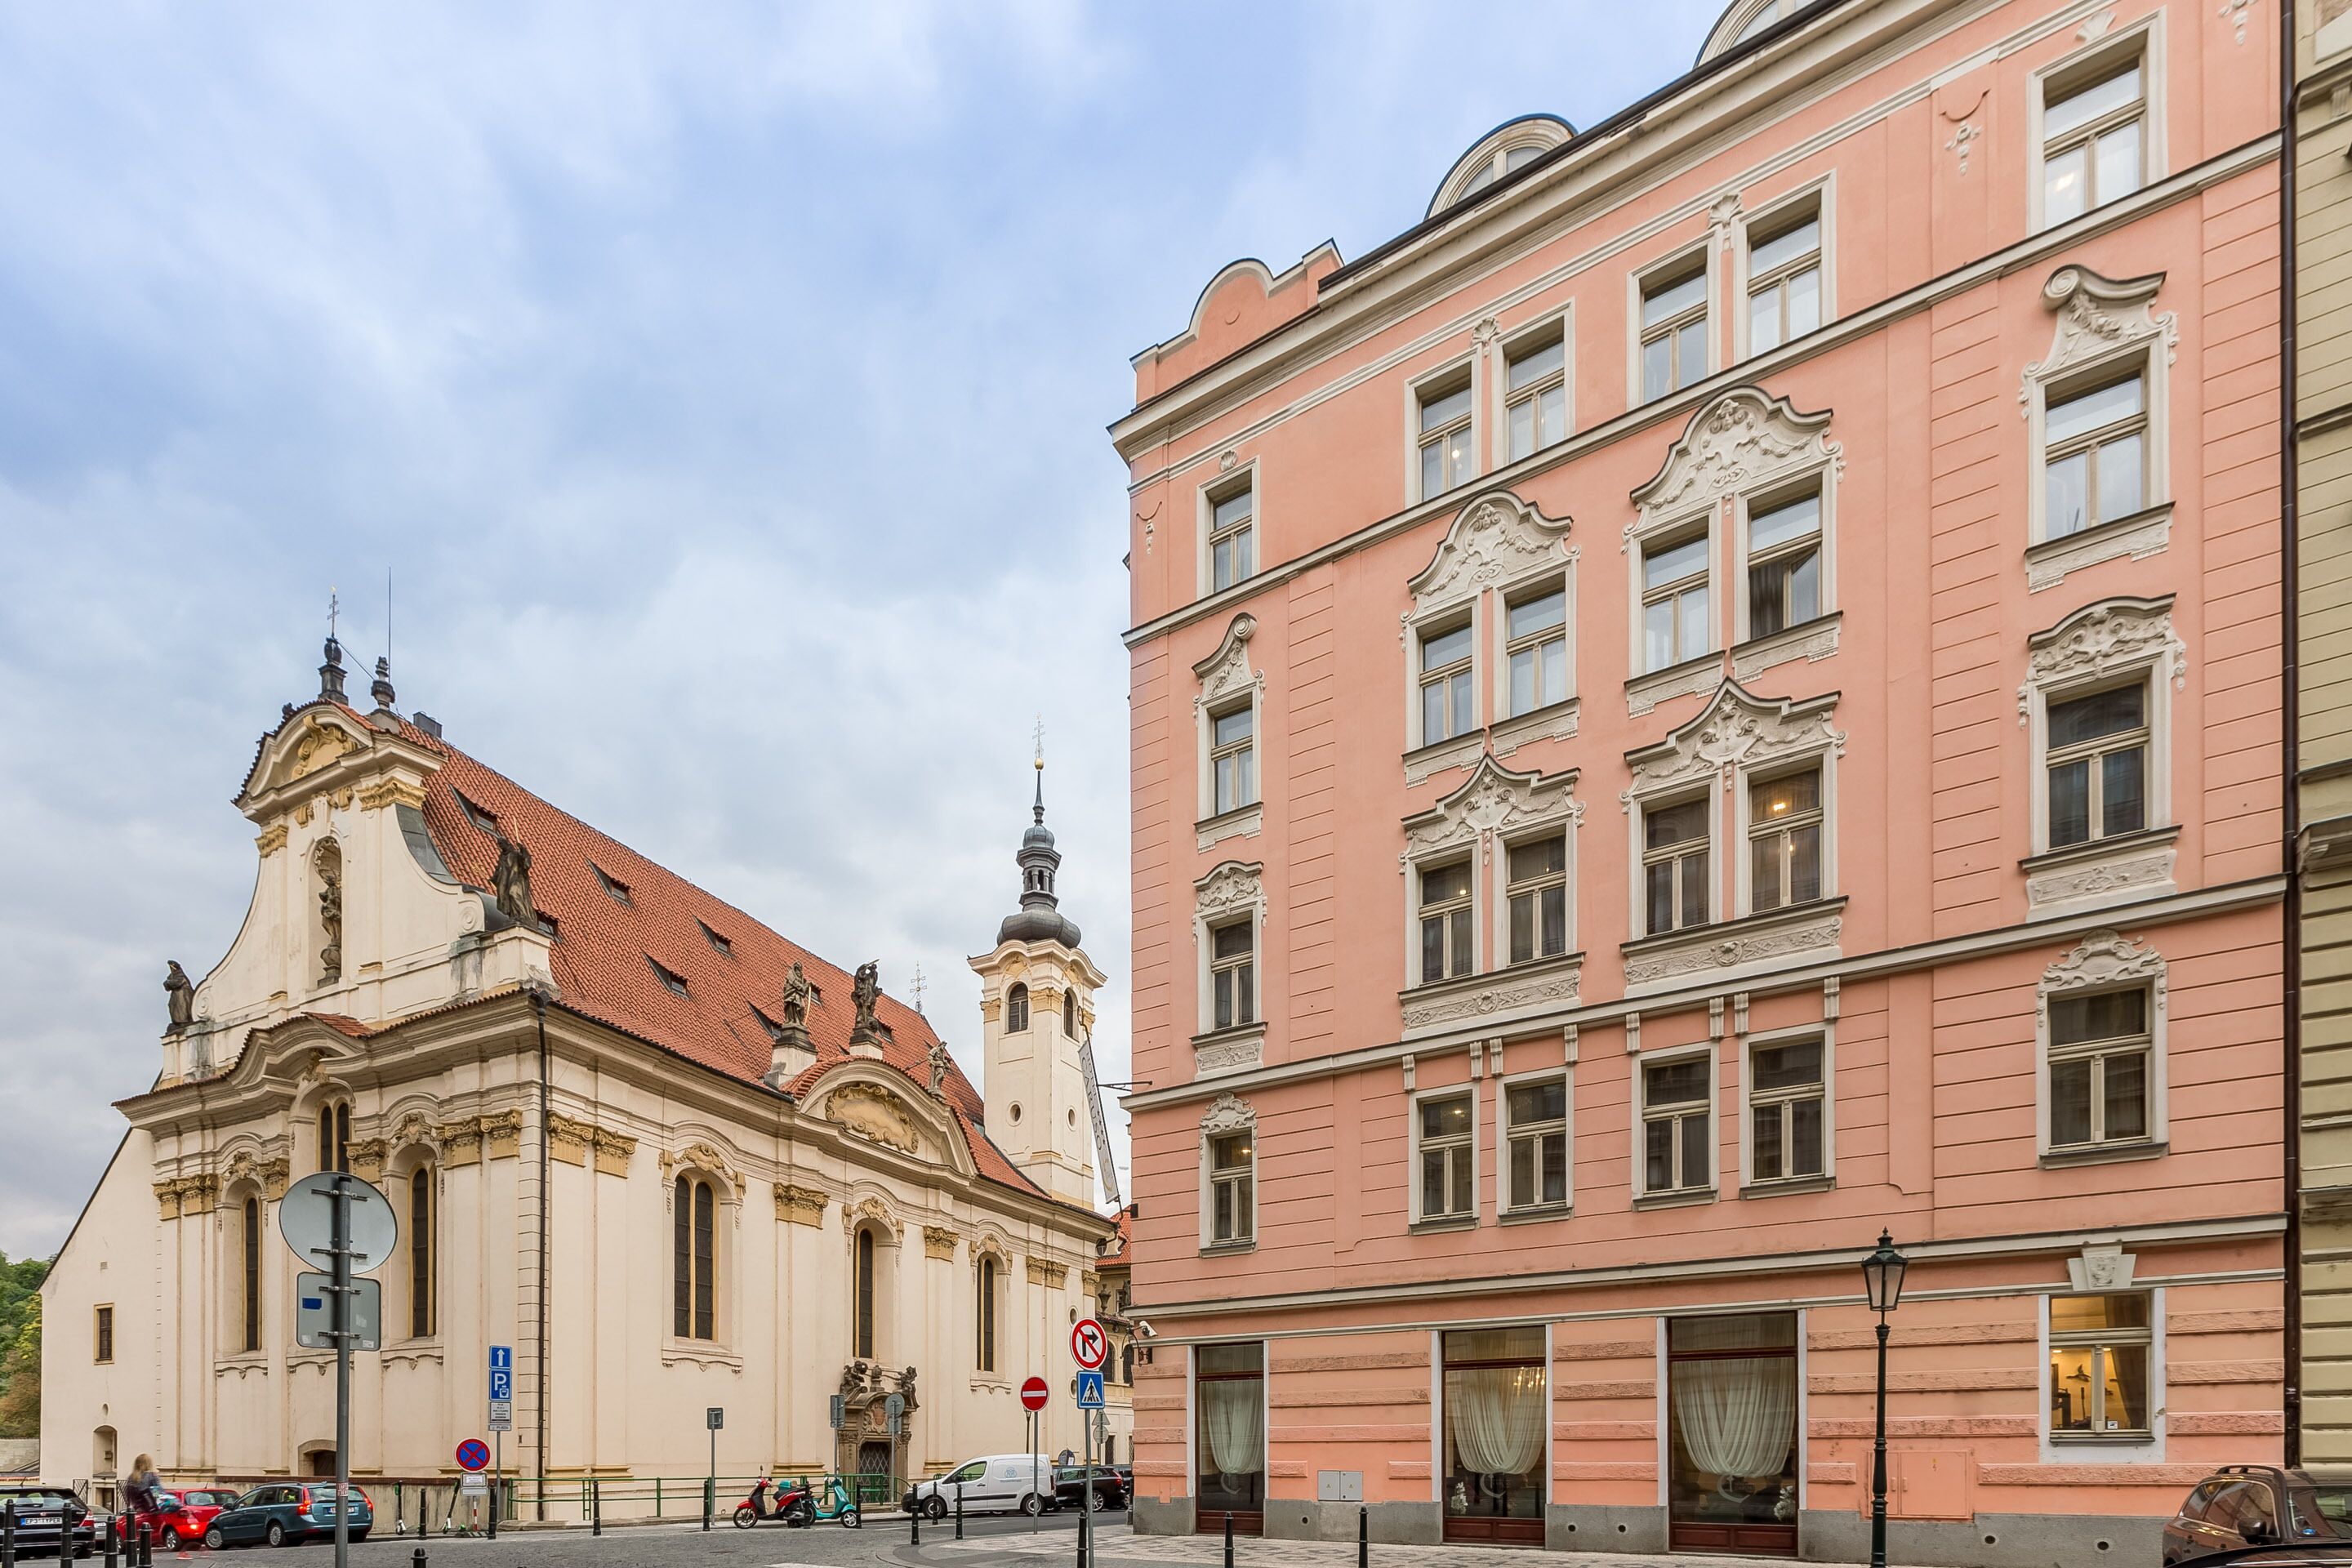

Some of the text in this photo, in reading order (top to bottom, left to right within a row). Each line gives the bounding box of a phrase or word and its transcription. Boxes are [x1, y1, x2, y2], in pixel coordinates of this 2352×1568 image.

[1086, 1051, 1097, 1097] HOTEL
[1081, 1057, 1102, 1151] CARUSO
[494, 1373, 507, 1391] P
